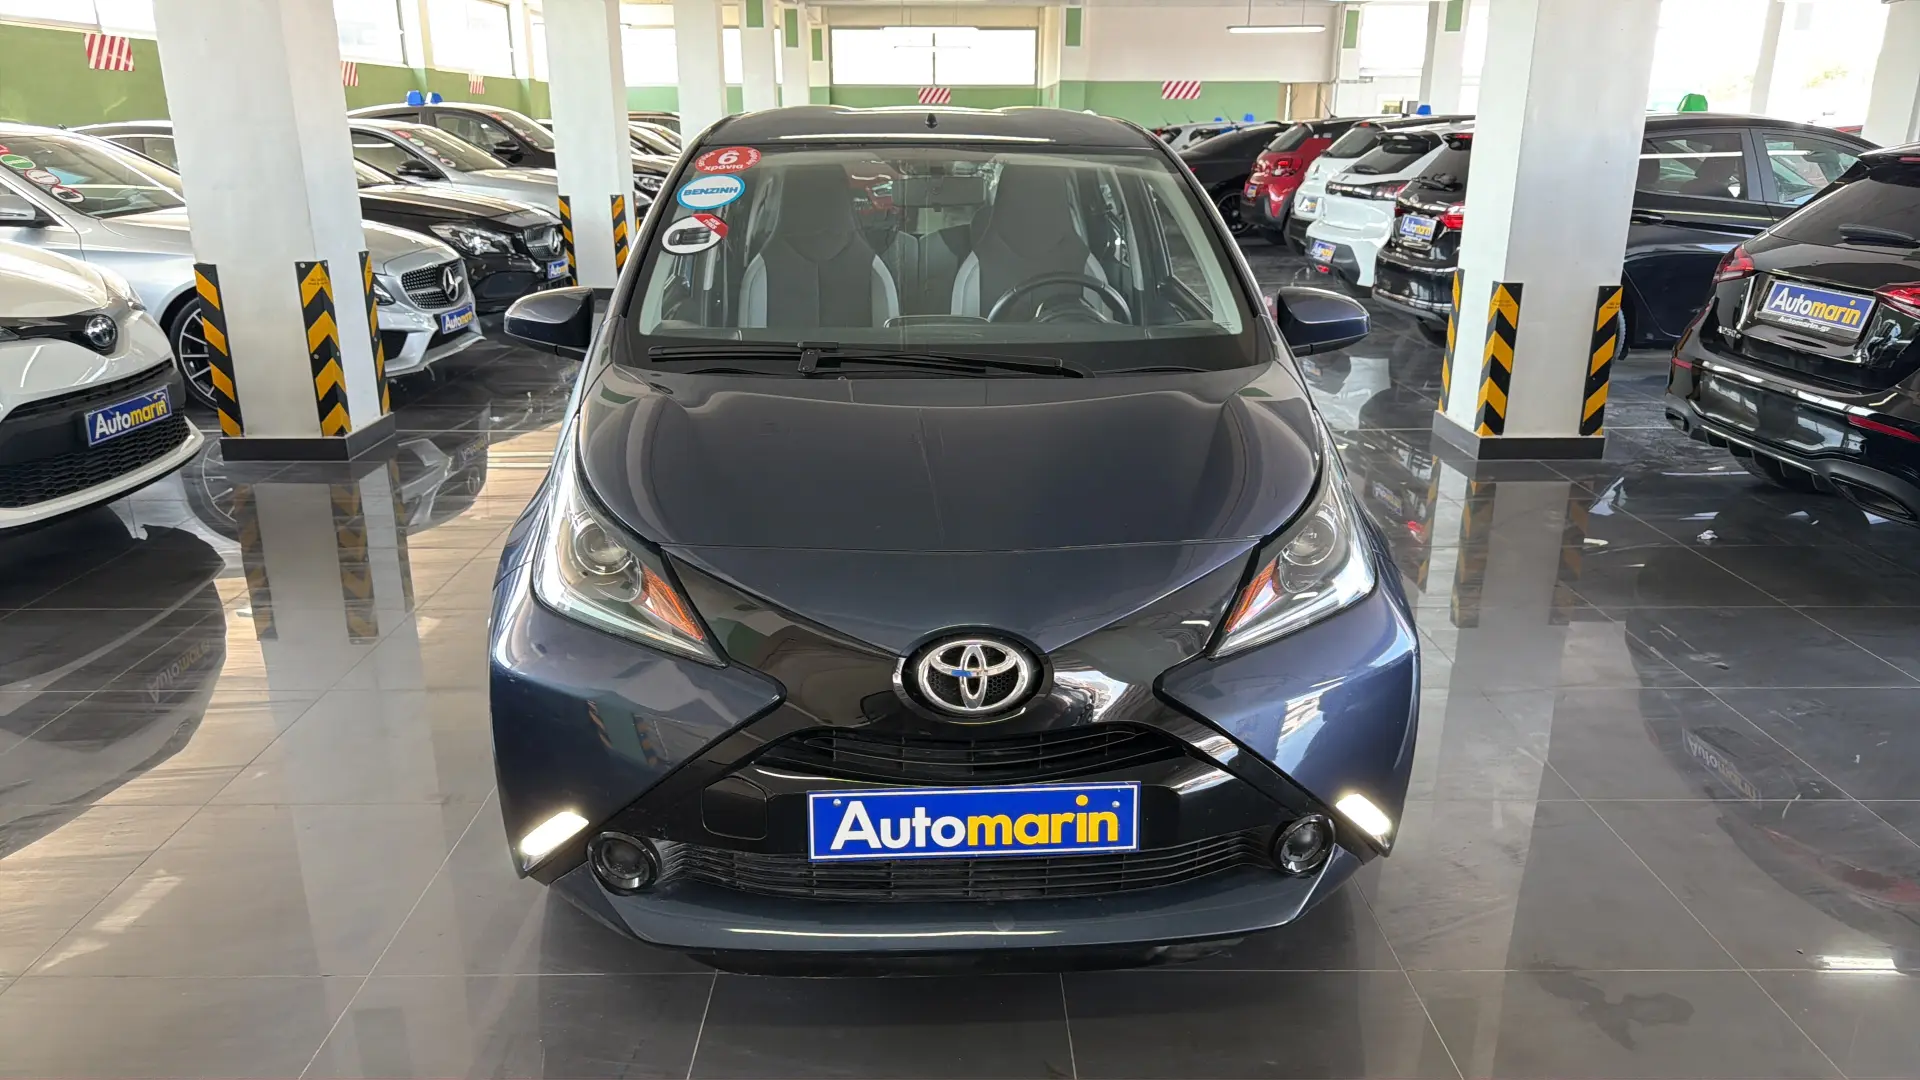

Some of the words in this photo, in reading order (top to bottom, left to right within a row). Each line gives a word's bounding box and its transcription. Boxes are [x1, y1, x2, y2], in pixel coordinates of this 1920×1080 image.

[718, 151, 740, 165] 6
[1771, 287, 1861, 326] Automarin
[94, 393, 168, 440] Automarin
[829, 794, 1119, 851] Automarin
